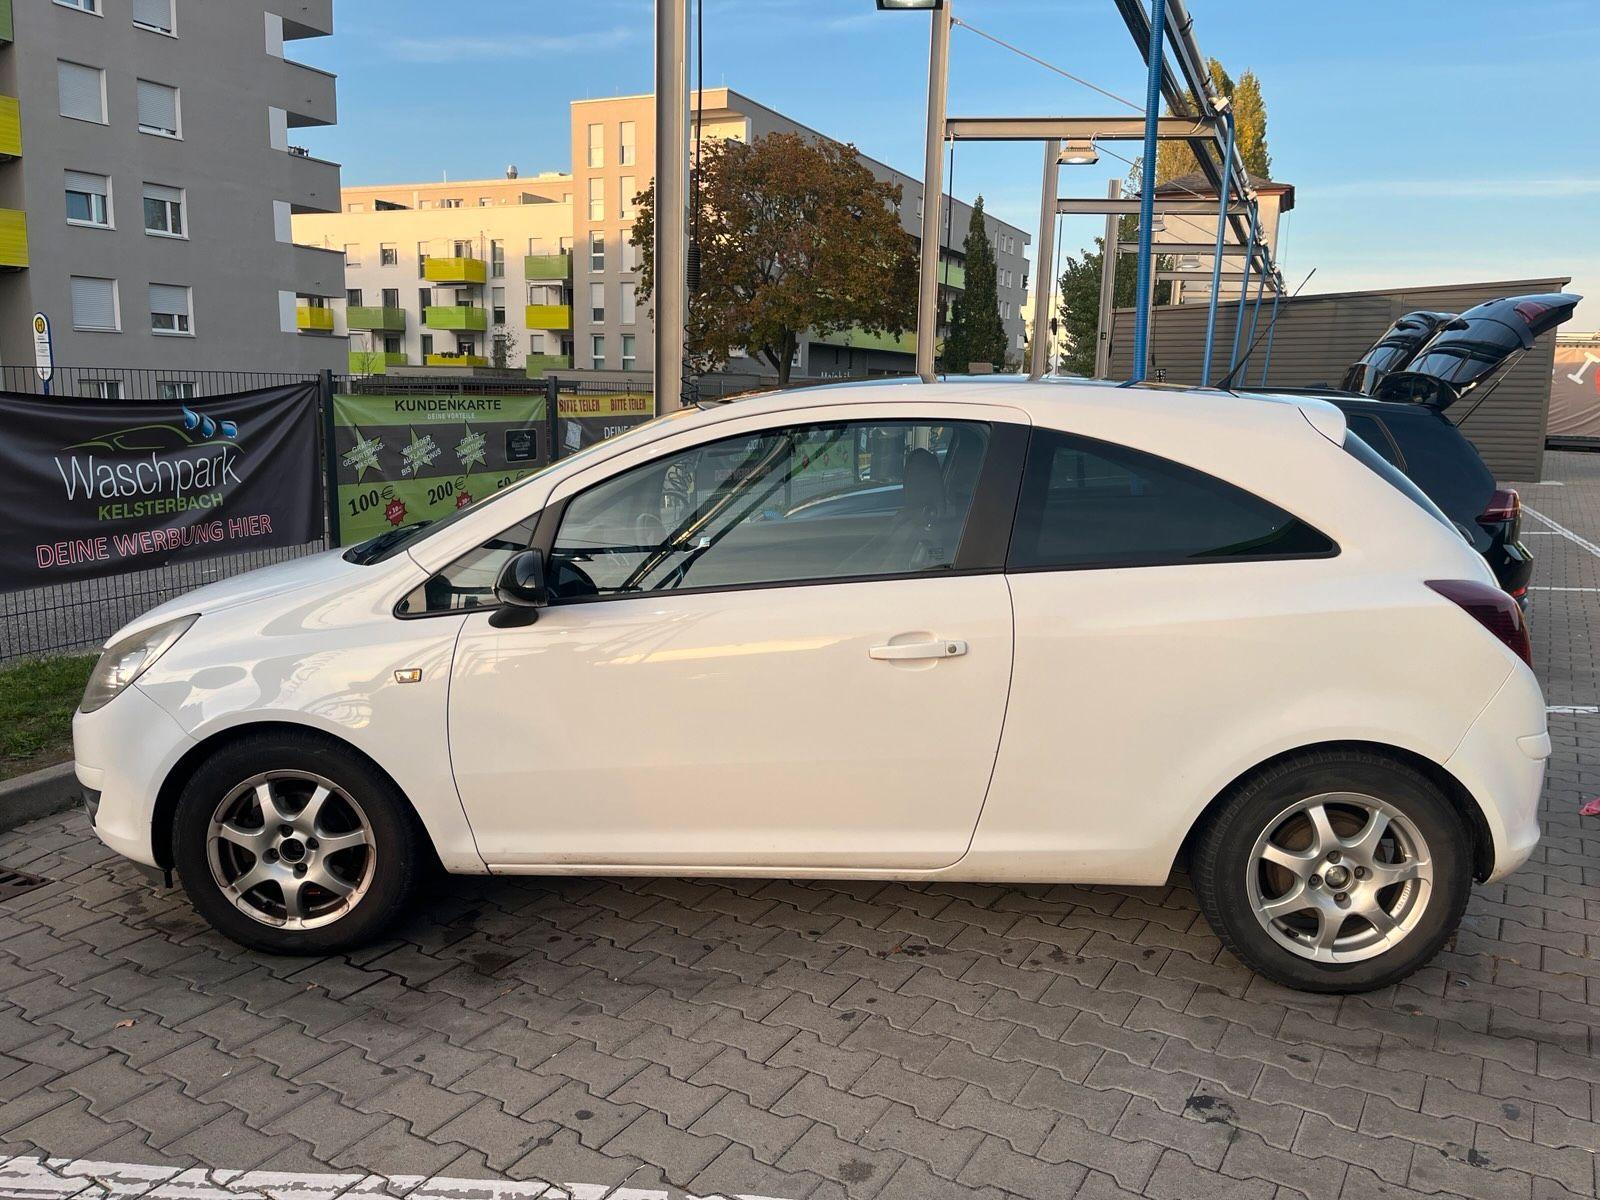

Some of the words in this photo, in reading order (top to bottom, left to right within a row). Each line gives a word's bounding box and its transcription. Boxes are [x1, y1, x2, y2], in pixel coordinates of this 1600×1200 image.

[395, 399, 502, 411] KUNDENKARTE
[558, 399, 578, 412] BITTE
[579, 399, 600, 412] TEILEN
[610, 399, 627, 411] BITTE
[628, 398, 646, 411] TEILEN
[446, 412, 475, 420] VORTEILE
[460, 432, 479, 445] GRATIS
[351, 439, 372, 453] GRATIS
[401, 465, 412, 476] BIS
[422, 447, 442, 463] BONUS
[55, 446, 242, 500] Waschpark
[98, 492, 224, 521] KELSTERBACH
[36, 537, 109, 568] DEINE
[113, 521, 224, 557] WERBUNG
[228, 514, 273, 539] HIER
